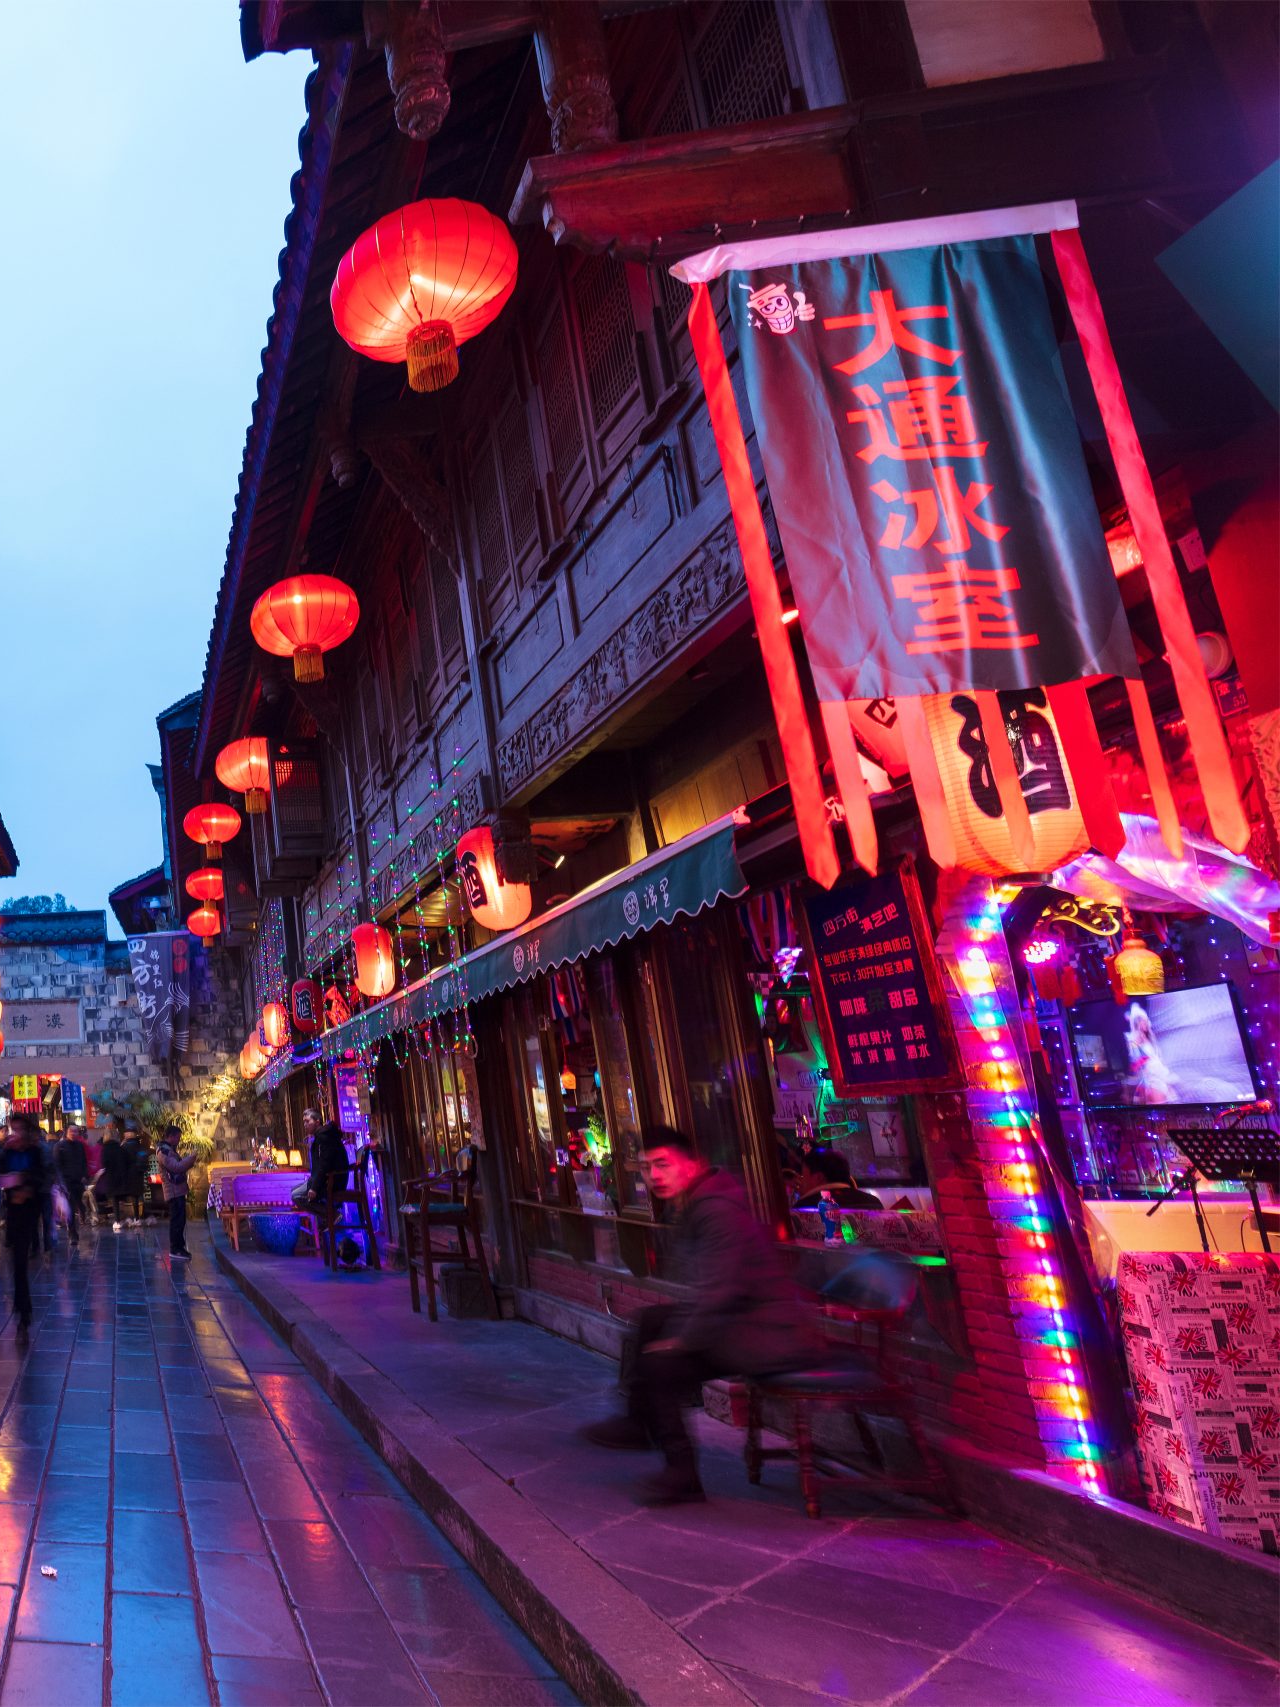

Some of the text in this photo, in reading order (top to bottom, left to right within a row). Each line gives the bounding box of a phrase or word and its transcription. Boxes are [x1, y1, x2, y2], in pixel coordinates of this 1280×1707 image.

[823, 290, 1039, 656] 大通冰室
[822, 906, 859, 937] 四方街
